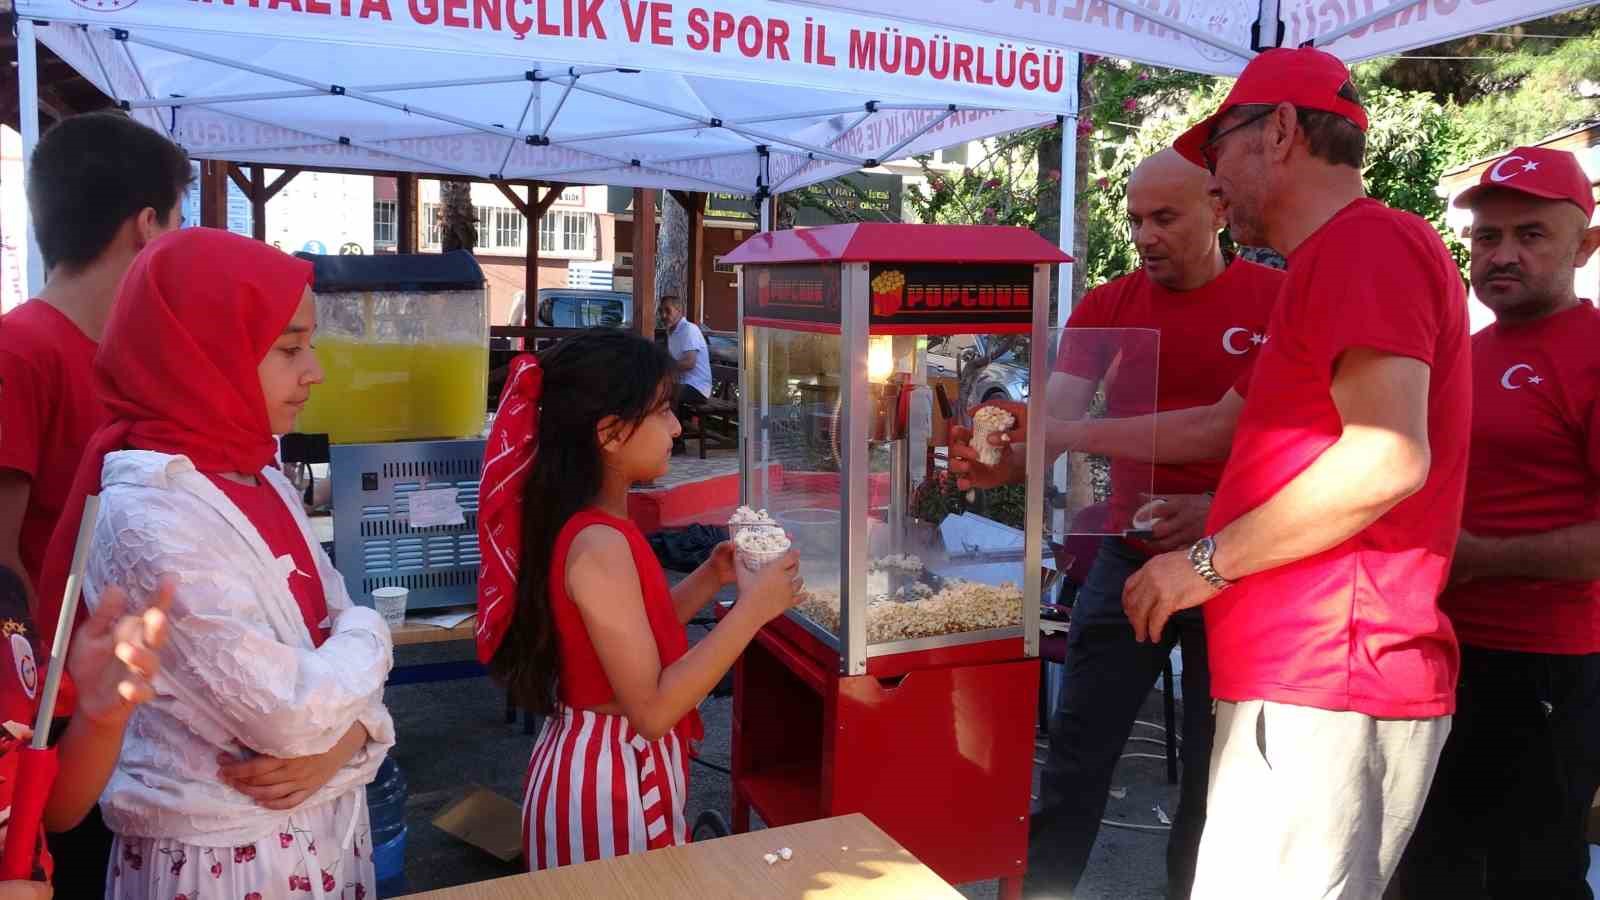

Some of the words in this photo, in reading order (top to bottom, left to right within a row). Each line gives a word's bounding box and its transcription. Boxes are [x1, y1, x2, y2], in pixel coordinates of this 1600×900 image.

[620, 0, 674, 46] VE
[686, 7, 790, 61] SPOR
[804, 17, 836, 65] İL
[849, 28, 1064, 93] MÜDÜRLÜĞÜ
